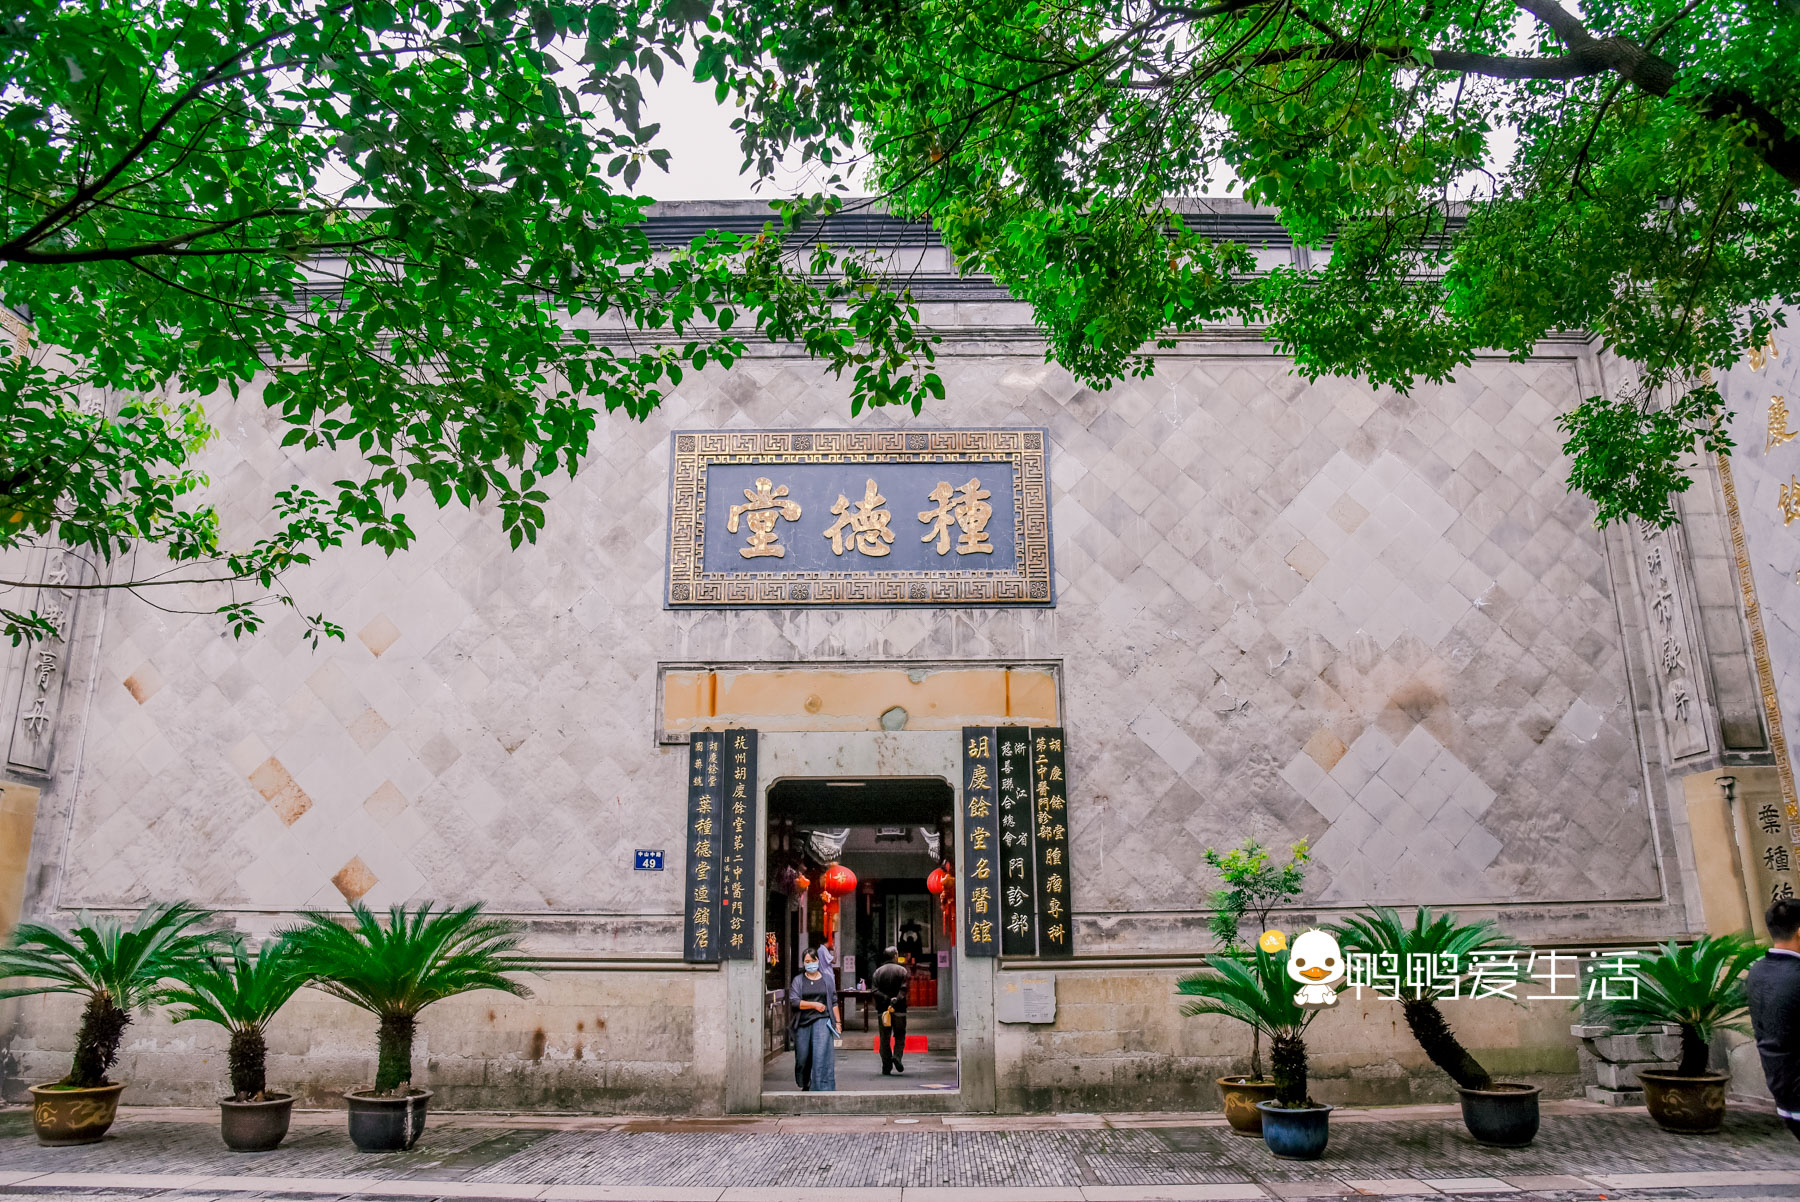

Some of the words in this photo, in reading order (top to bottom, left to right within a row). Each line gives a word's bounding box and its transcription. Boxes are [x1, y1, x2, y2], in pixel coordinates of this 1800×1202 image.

[727, 477, 994, 558] 種德堂
[1049, 738, 1066, 840] 胡慶餘堂
[642, 858, 656, 868] 49
[1006, 857, 1029, 937] 門診部
